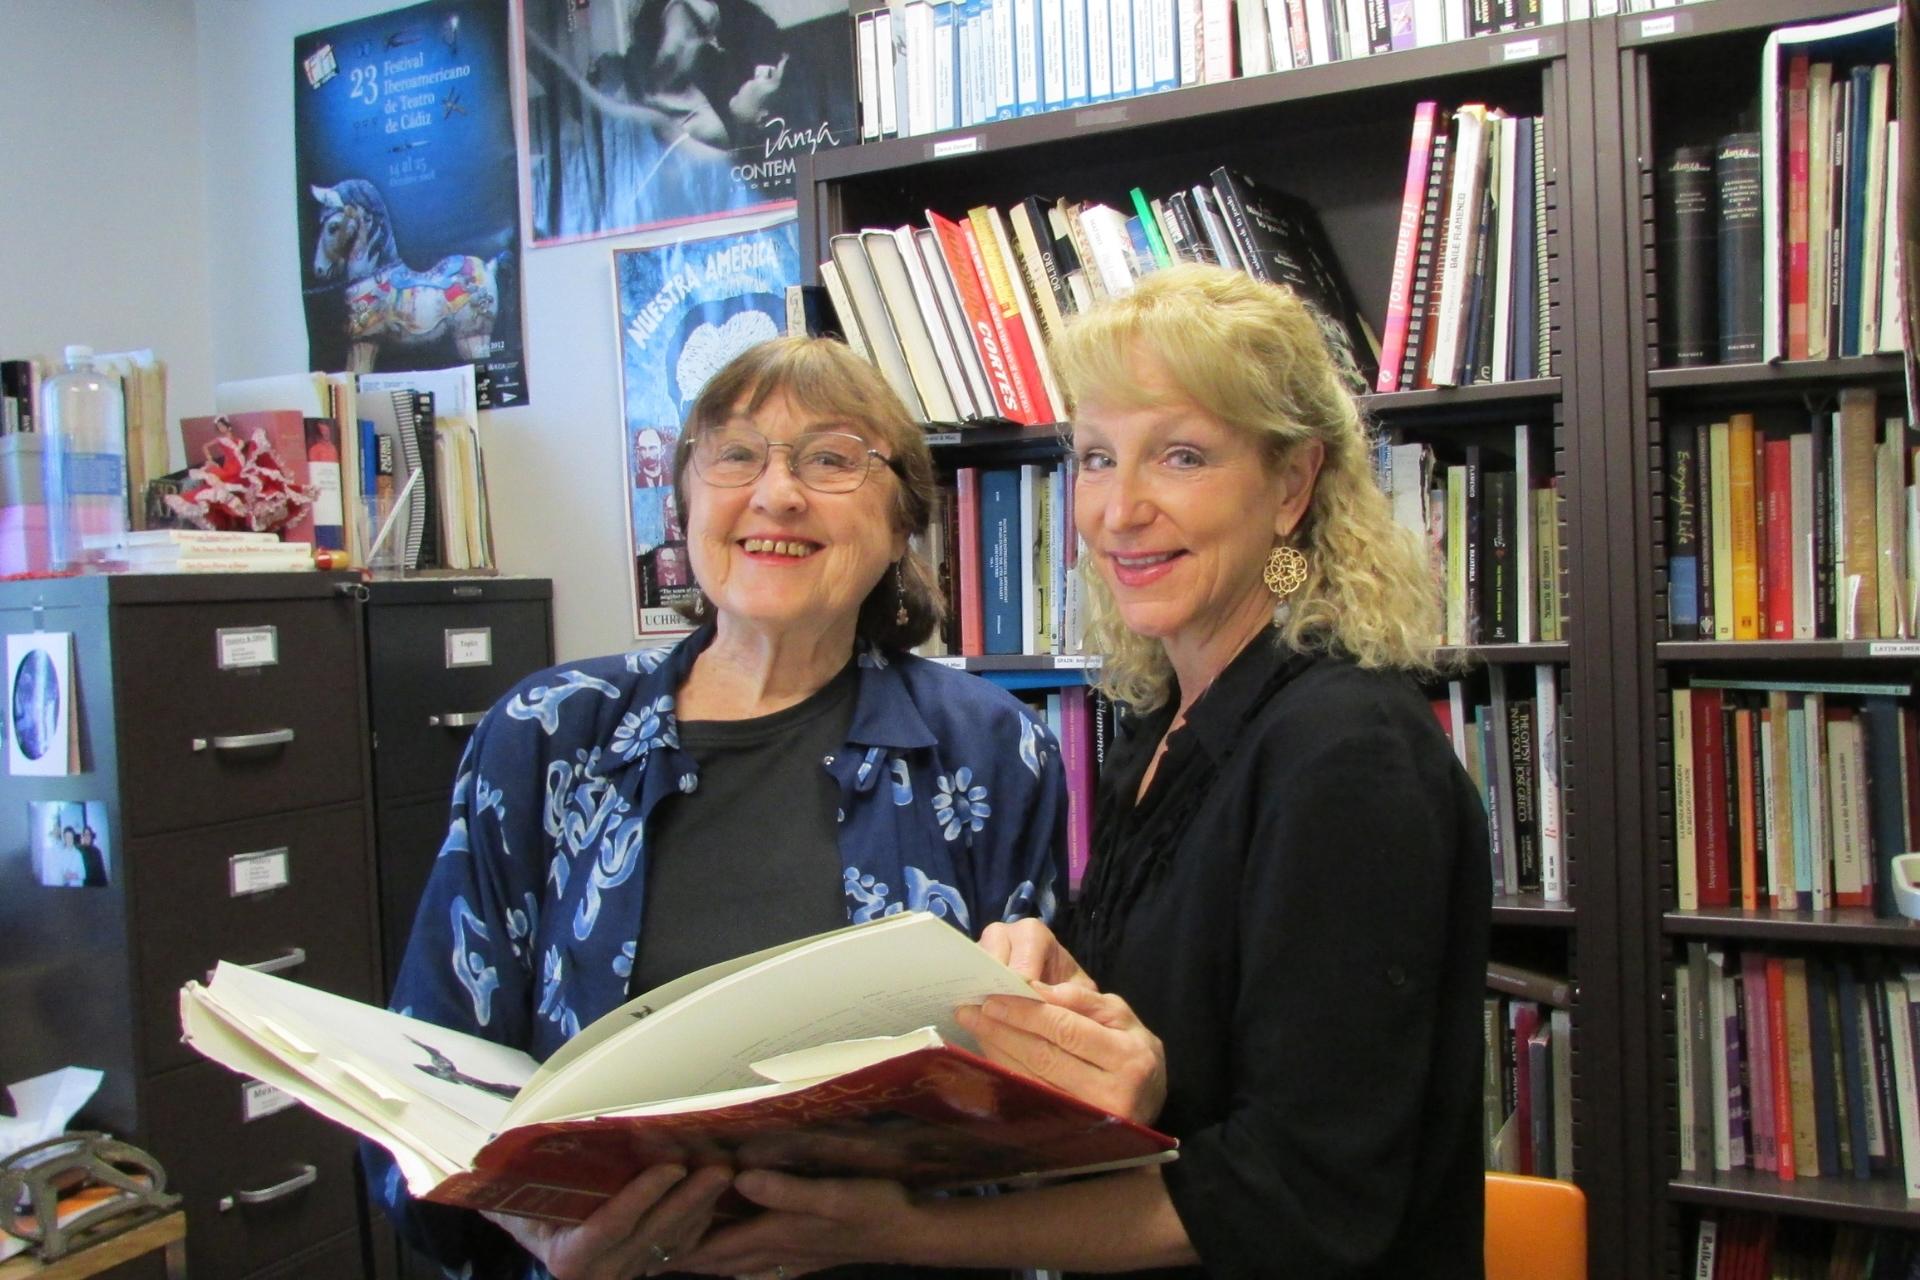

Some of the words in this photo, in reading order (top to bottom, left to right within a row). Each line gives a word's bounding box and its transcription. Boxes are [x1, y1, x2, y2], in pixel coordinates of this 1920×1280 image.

[384, 52, 424, 76] Festival
[351, 64, 379, 105] 23
[384, 64, 471, 95] Iberoamericano
[384, 100, 398, 115] de
[401, 92, 435, 111] Teatro
[385, 119, 399, 134] de
[401, 112, 432, 131] Cádiz
[765, 117, 840, 159] Danza
[1835, 132, 1843, 166] MEMORIA
[402, 157, 412, 173] al
[730, 158, 797, 182] CONTEM
[1226, 196, 1241, 217] jondo
[1452, 192, 1466, 241] FLAMENCO
[1163, 209, 1184, 243] CARMEN
[1236, 218, 1243, 227] lo
[1240, 228, 1247, 236] de
[966, 231, 980, 254] Español
[974, 254, 983, 270] Baile
[1388, 202, 1418, 311] ¡Flamenco!
[1430, 217, 1451, 294] Flamenco
[1449, 243, 1461, 269] BAILE
[996, 263, 1011, 286] Danza
[1043, 252, 1061, 291] BOLERO
[627, 262, 700, 350] NUESTRA
[705, 236, 780, 281] AMÉRICA
[980, 277, 993, 299] Archivo
[1427, 302, 1441, 316] El
[998, 330, 1013, 353] MARIA
[976, 321, 1019, 412] CORTÉS
[1006, 353, 1017, 372] JUAN
[1011, 372, 1031, 413] COLECCION
[1670, 450, 1695, 516] Everynight
[1675, 520, 1695, 545] Life
[460, 640, 478, 648] Topics
[1510, 707, 1519, 719] IN
[1519, 713, 1530, 731] THE
[1510, 719, 1520, 736] MY
[1511, 736, 1521, 761] SOUL
[1520, 731, 1531, 762] GYPSY
[1515, 766, 1525, 786] JOSE
[1516, 788, 1527, 822] GRECO
[1544, 787, 1557, 839] Rosario
[1707, 850, 1715, 858] de
[1707, 858, 1716, 889] Despertar
[1699, 1236, 1713, 1278] Balkan
